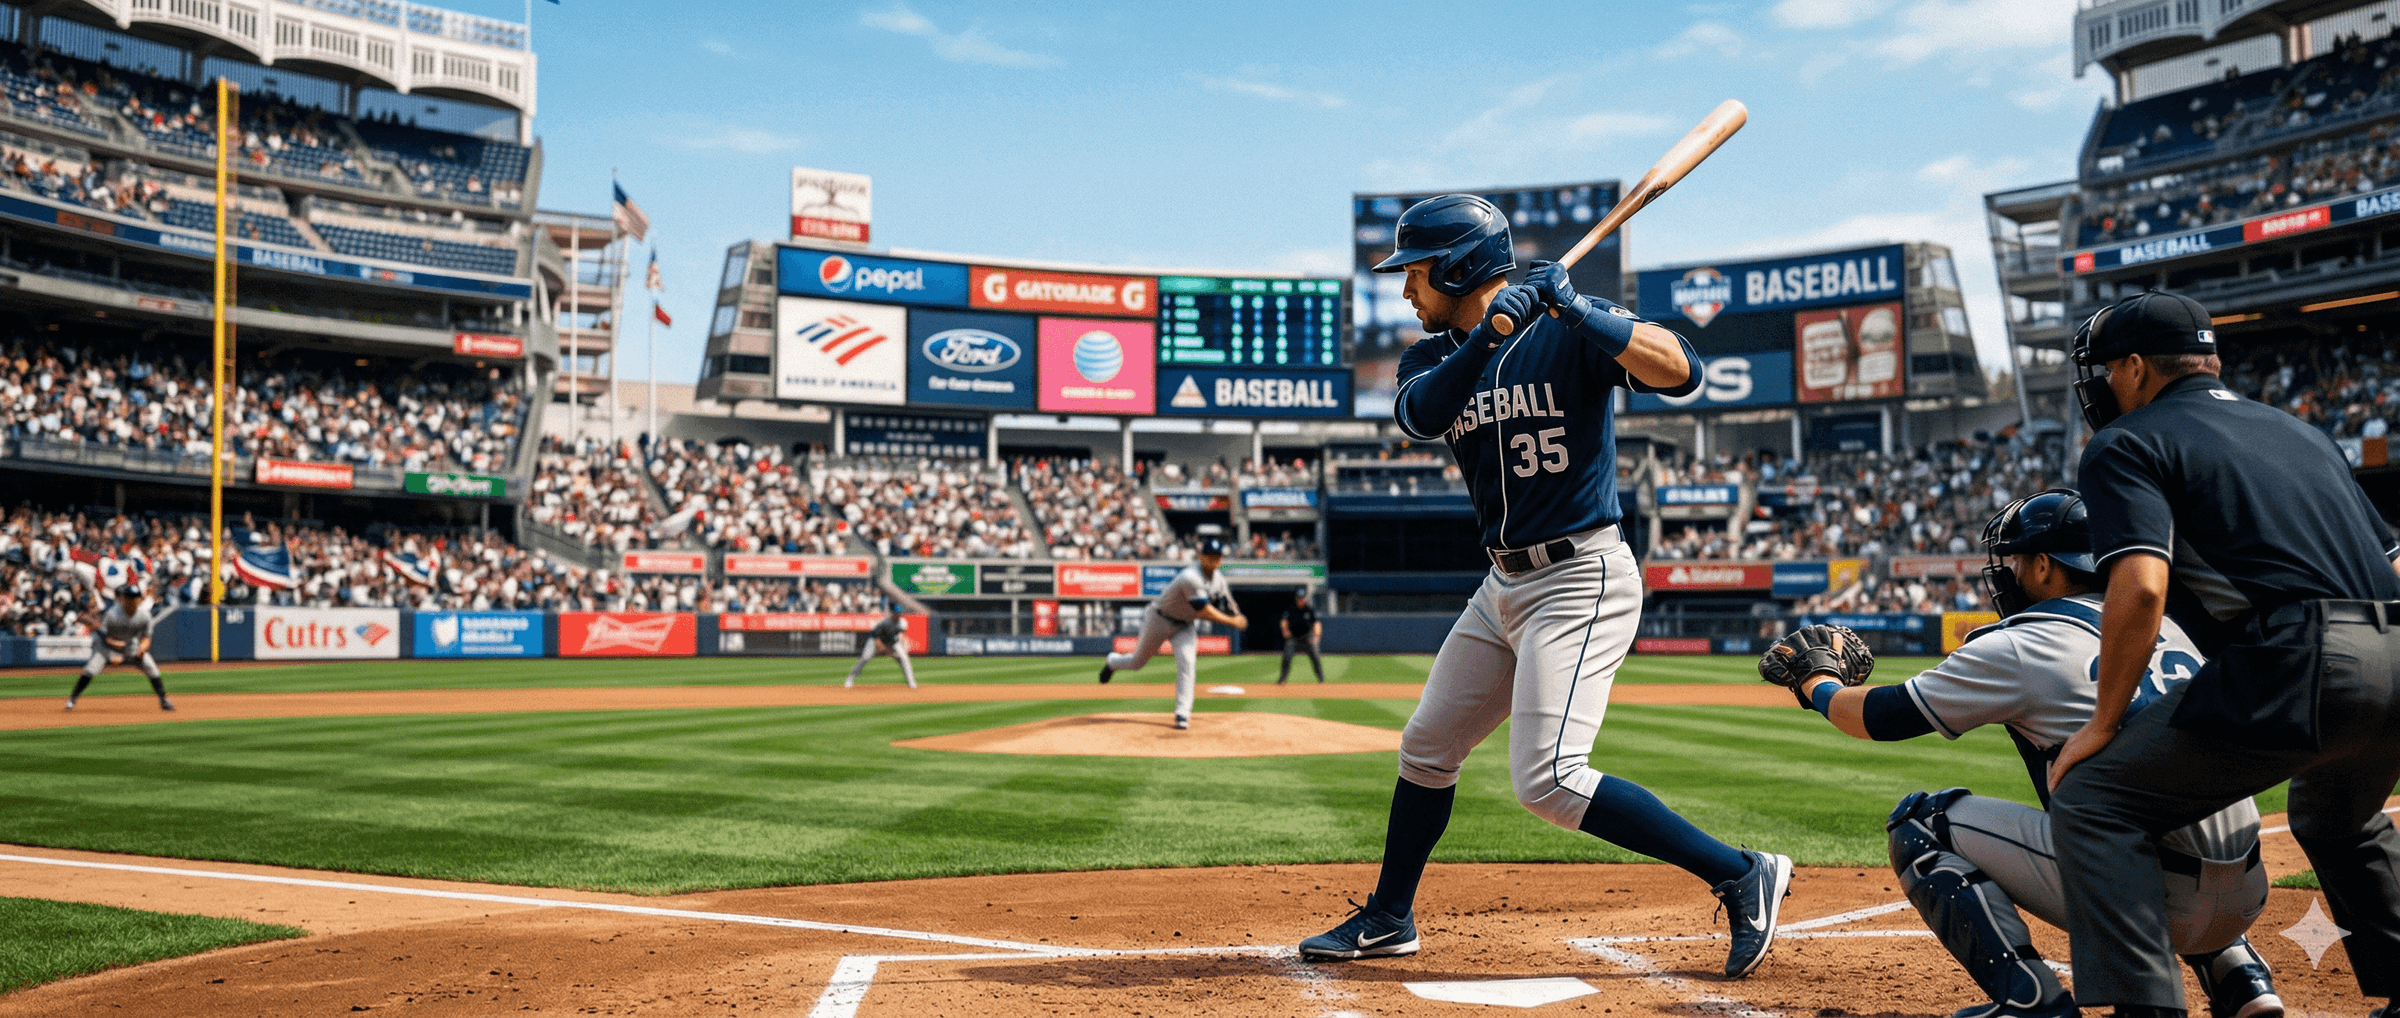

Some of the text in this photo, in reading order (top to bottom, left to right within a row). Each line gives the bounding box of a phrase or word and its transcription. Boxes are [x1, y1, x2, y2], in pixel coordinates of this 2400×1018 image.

[252, 248, 326, 275] BASEBALL
[2120, 233, 2211, 266] BASEBALL
[983, 273, 1147, 310] G GATORADE G
[1746, 255, 1897, 306] BASEBALL
[939, 335, 1003, 365] Ford
[1214, 377, 1339, 408] BASEBALL
[1450, 383, 1565, 445] ASEBALL
[1510, 427, 1569, 479] 35
[264, 616, 347, 650] Cutrs
